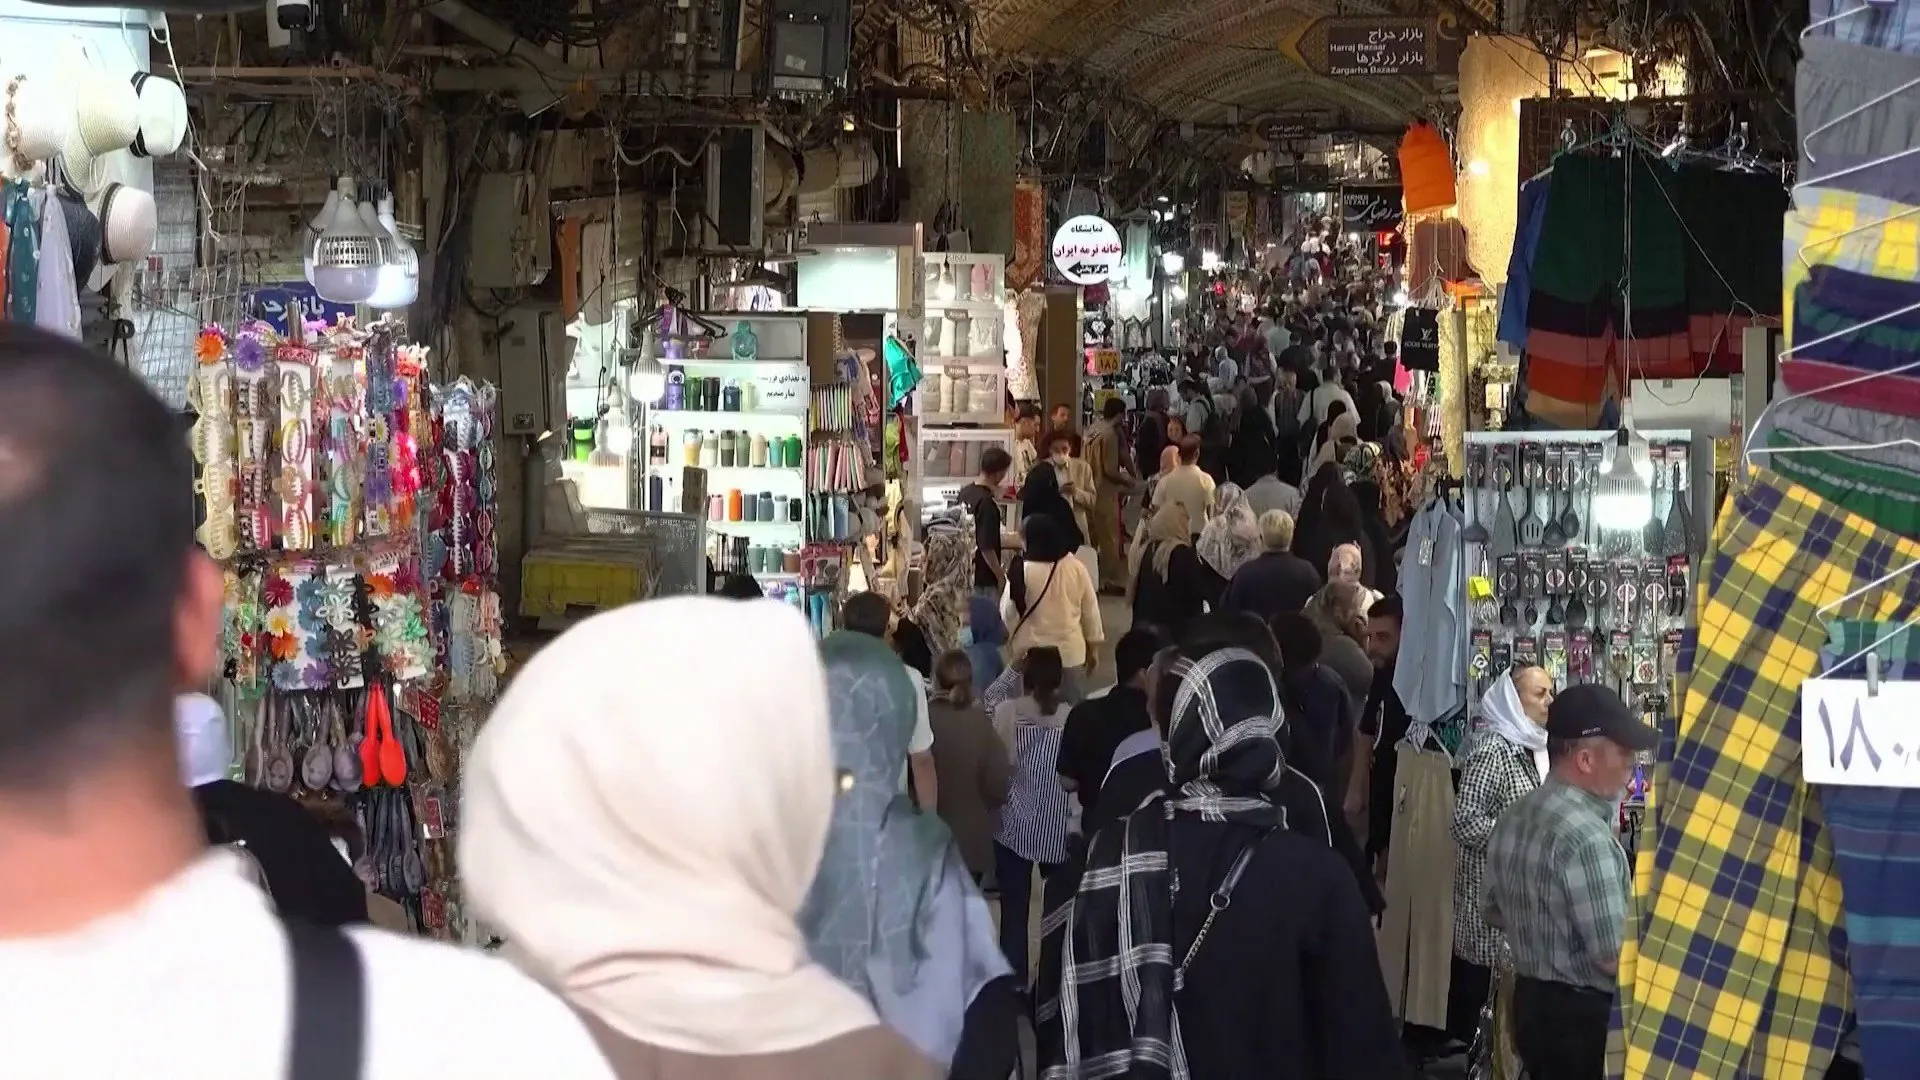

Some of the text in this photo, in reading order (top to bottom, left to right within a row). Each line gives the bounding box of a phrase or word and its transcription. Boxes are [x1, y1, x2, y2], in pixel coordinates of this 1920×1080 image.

[1368, 28, 1423, 44] بازار حراج
[1330, 44, 1387, 53] Harraj Bazaar
[1356, 51, 1423, 66] بازار زرگرها
[1330, 67, 1368, 75] Zargarha
[1071, 223, 1103, 234] نمایشگاه
[1054, 244, 1077, 257] ایران
[1101, 243, 1121, 254] خانه
